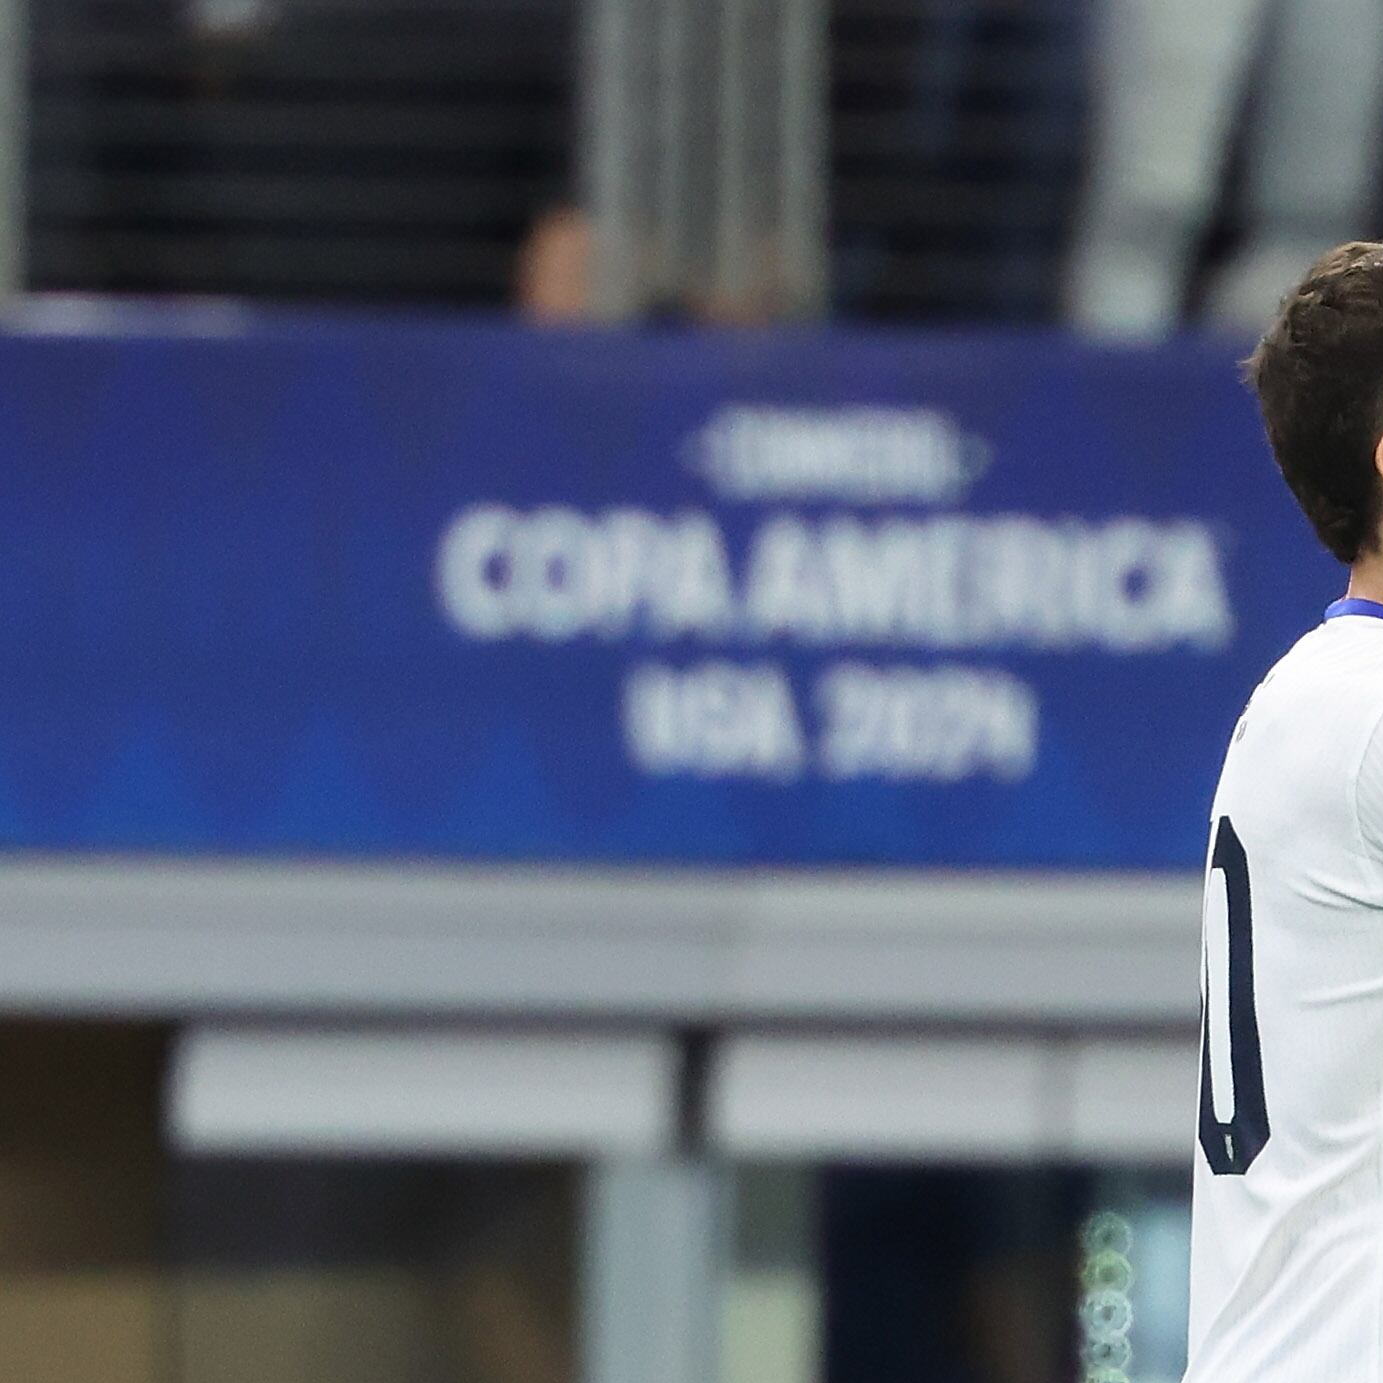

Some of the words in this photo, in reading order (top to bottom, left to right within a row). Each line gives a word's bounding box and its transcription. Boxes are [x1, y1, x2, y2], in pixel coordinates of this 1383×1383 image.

[437, 503, 734, 641] COPA
[742, 509, 1237, 651] AMERICA
[623, 661, 803, 782] USA
